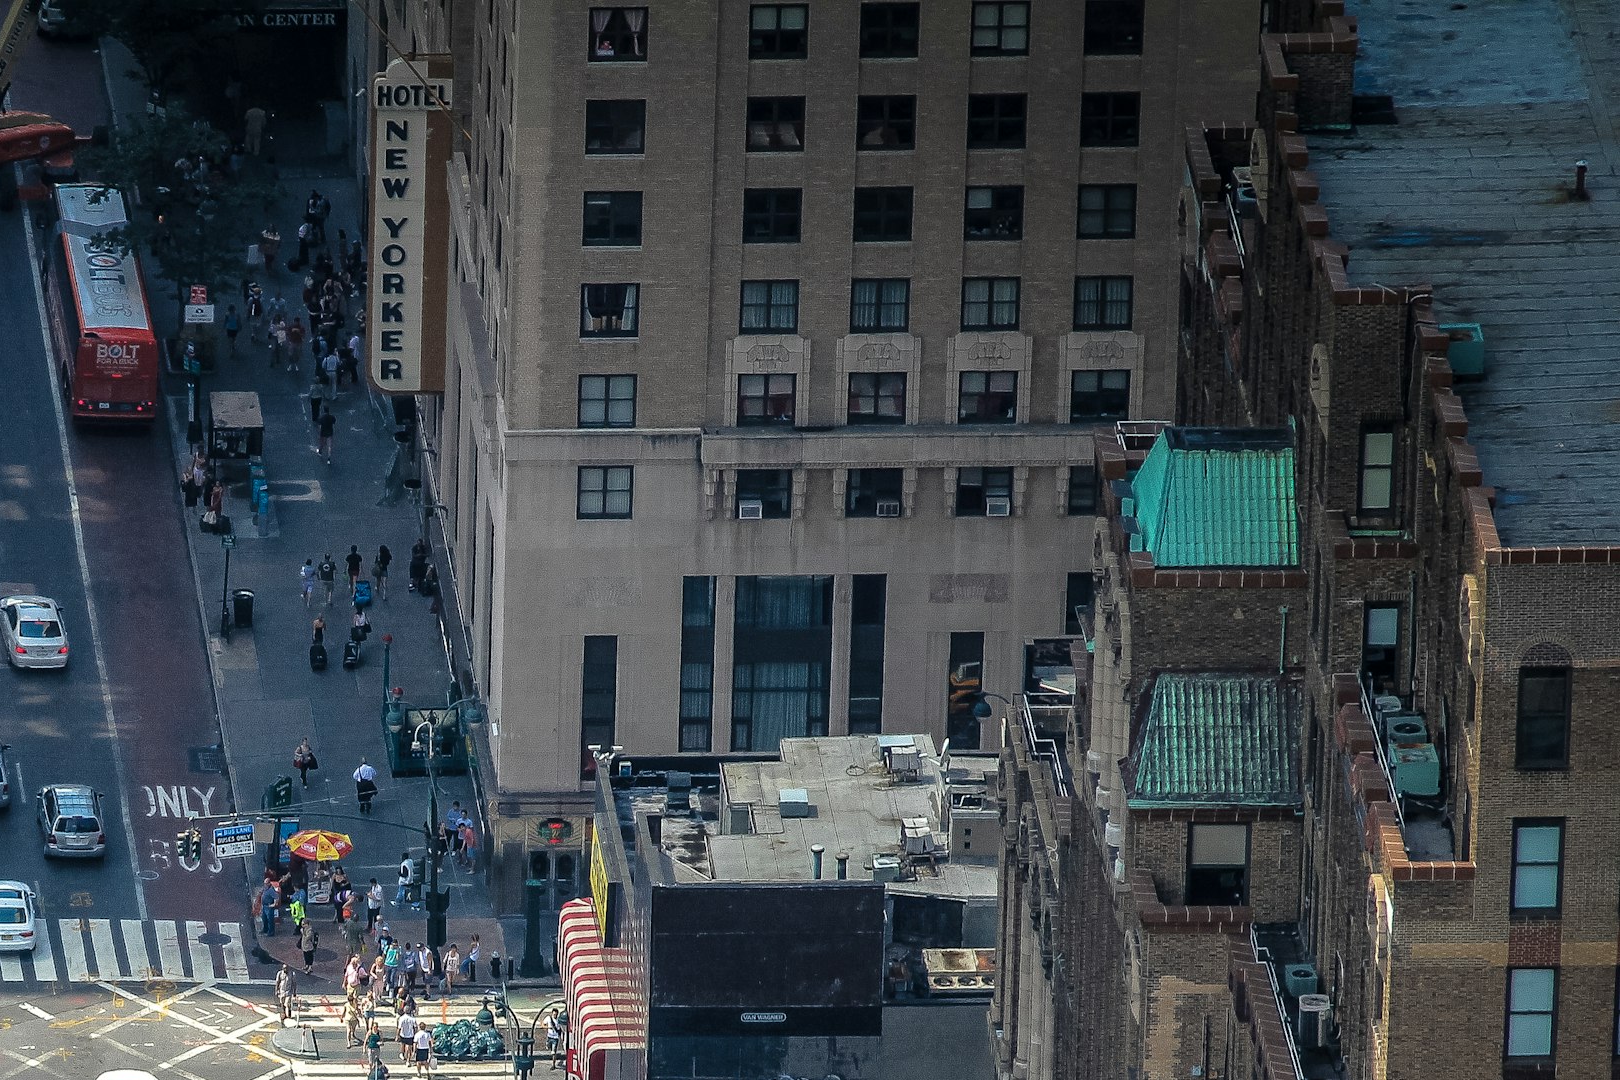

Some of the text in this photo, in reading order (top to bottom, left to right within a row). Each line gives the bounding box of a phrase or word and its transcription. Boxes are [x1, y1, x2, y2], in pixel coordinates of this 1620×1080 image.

[262, 14, 336, 26] CENTER
[377, 85, 450, 106] HOTEL
[380, 120, 410, 380] NEW YORKER
[96, 344, 140, 359] BOLT
[223, 826, 252, 836] BUS LANE
[236, 833, 252, 841] ONLY
